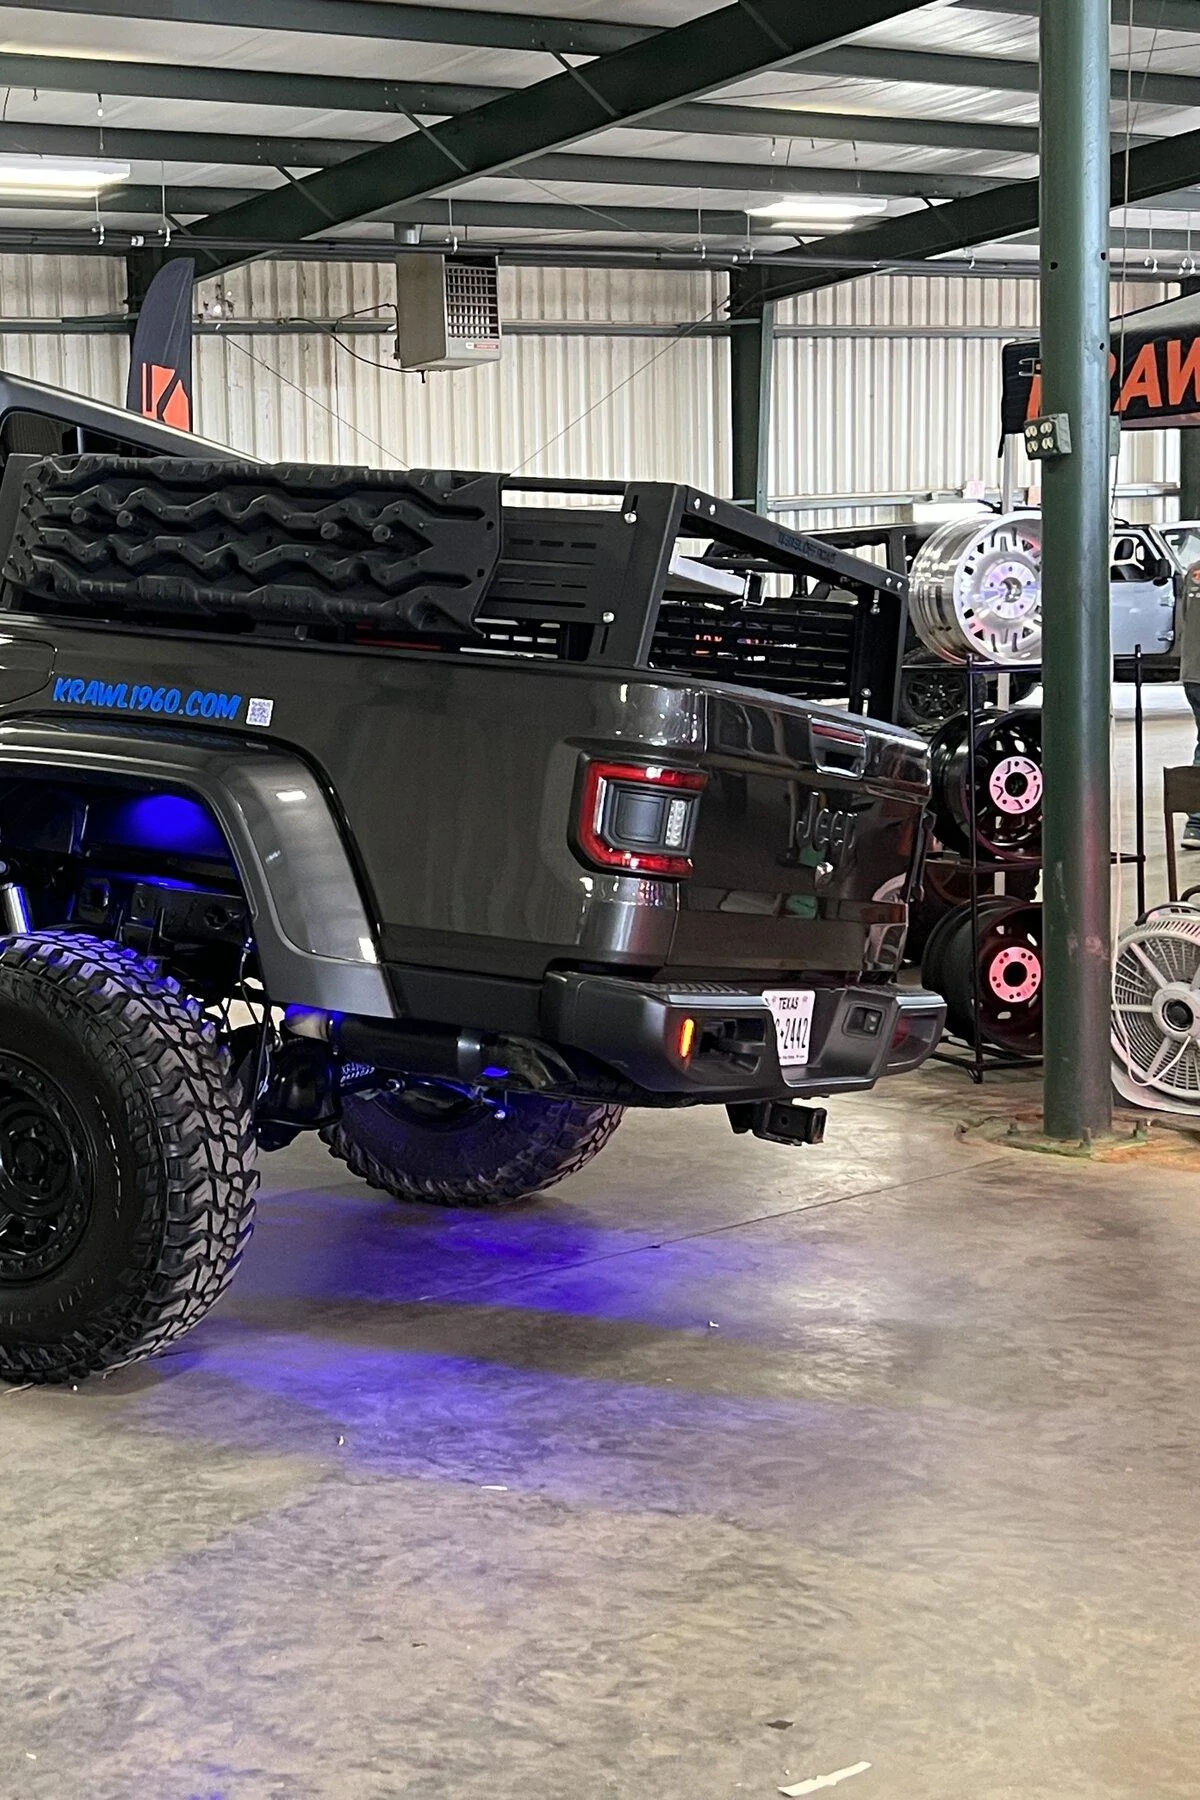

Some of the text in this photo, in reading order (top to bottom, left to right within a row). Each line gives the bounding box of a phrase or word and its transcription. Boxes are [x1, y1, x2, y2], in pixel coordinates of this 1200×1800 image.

[52, 677, 242, 720] KRAWL1960.COM
[795, 791, 859, 866] Jeep
[778, 996, 799, 1010] TEXAS
